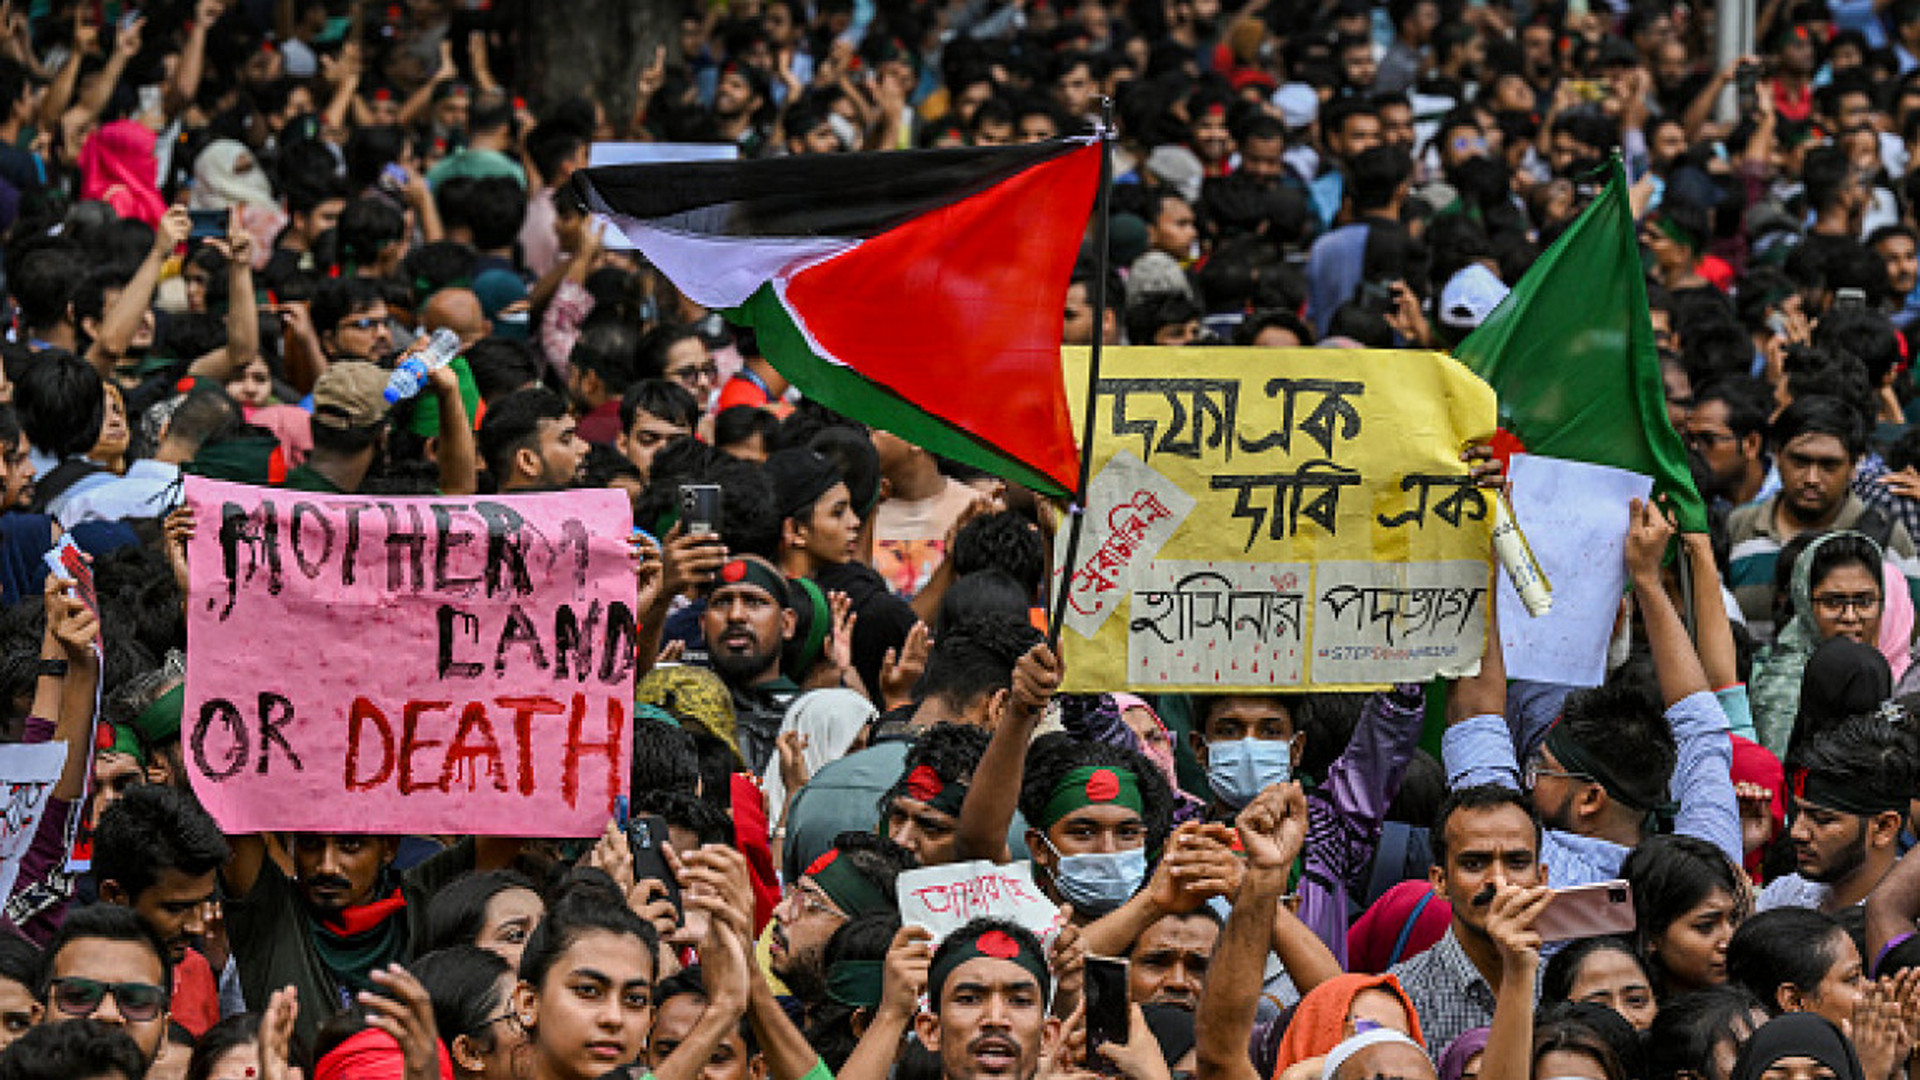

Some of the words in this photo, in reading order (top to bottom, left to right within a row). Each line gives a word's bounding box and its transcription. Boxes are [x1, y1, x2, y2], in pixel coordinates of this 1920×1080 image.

[1099, 378, 1239, 462] দফা
[1237, 378, 1364, 459] এক
[1209, 458, 1362, 552] দাবি
[1378, 473, 1488, 529] এক
[437, 600, 636, 685] LAND
[1130, 571, 1304, 645] হাসিনার
[190, 691, 303, 782] OR
[344, 692, 625, 810] DEATH
